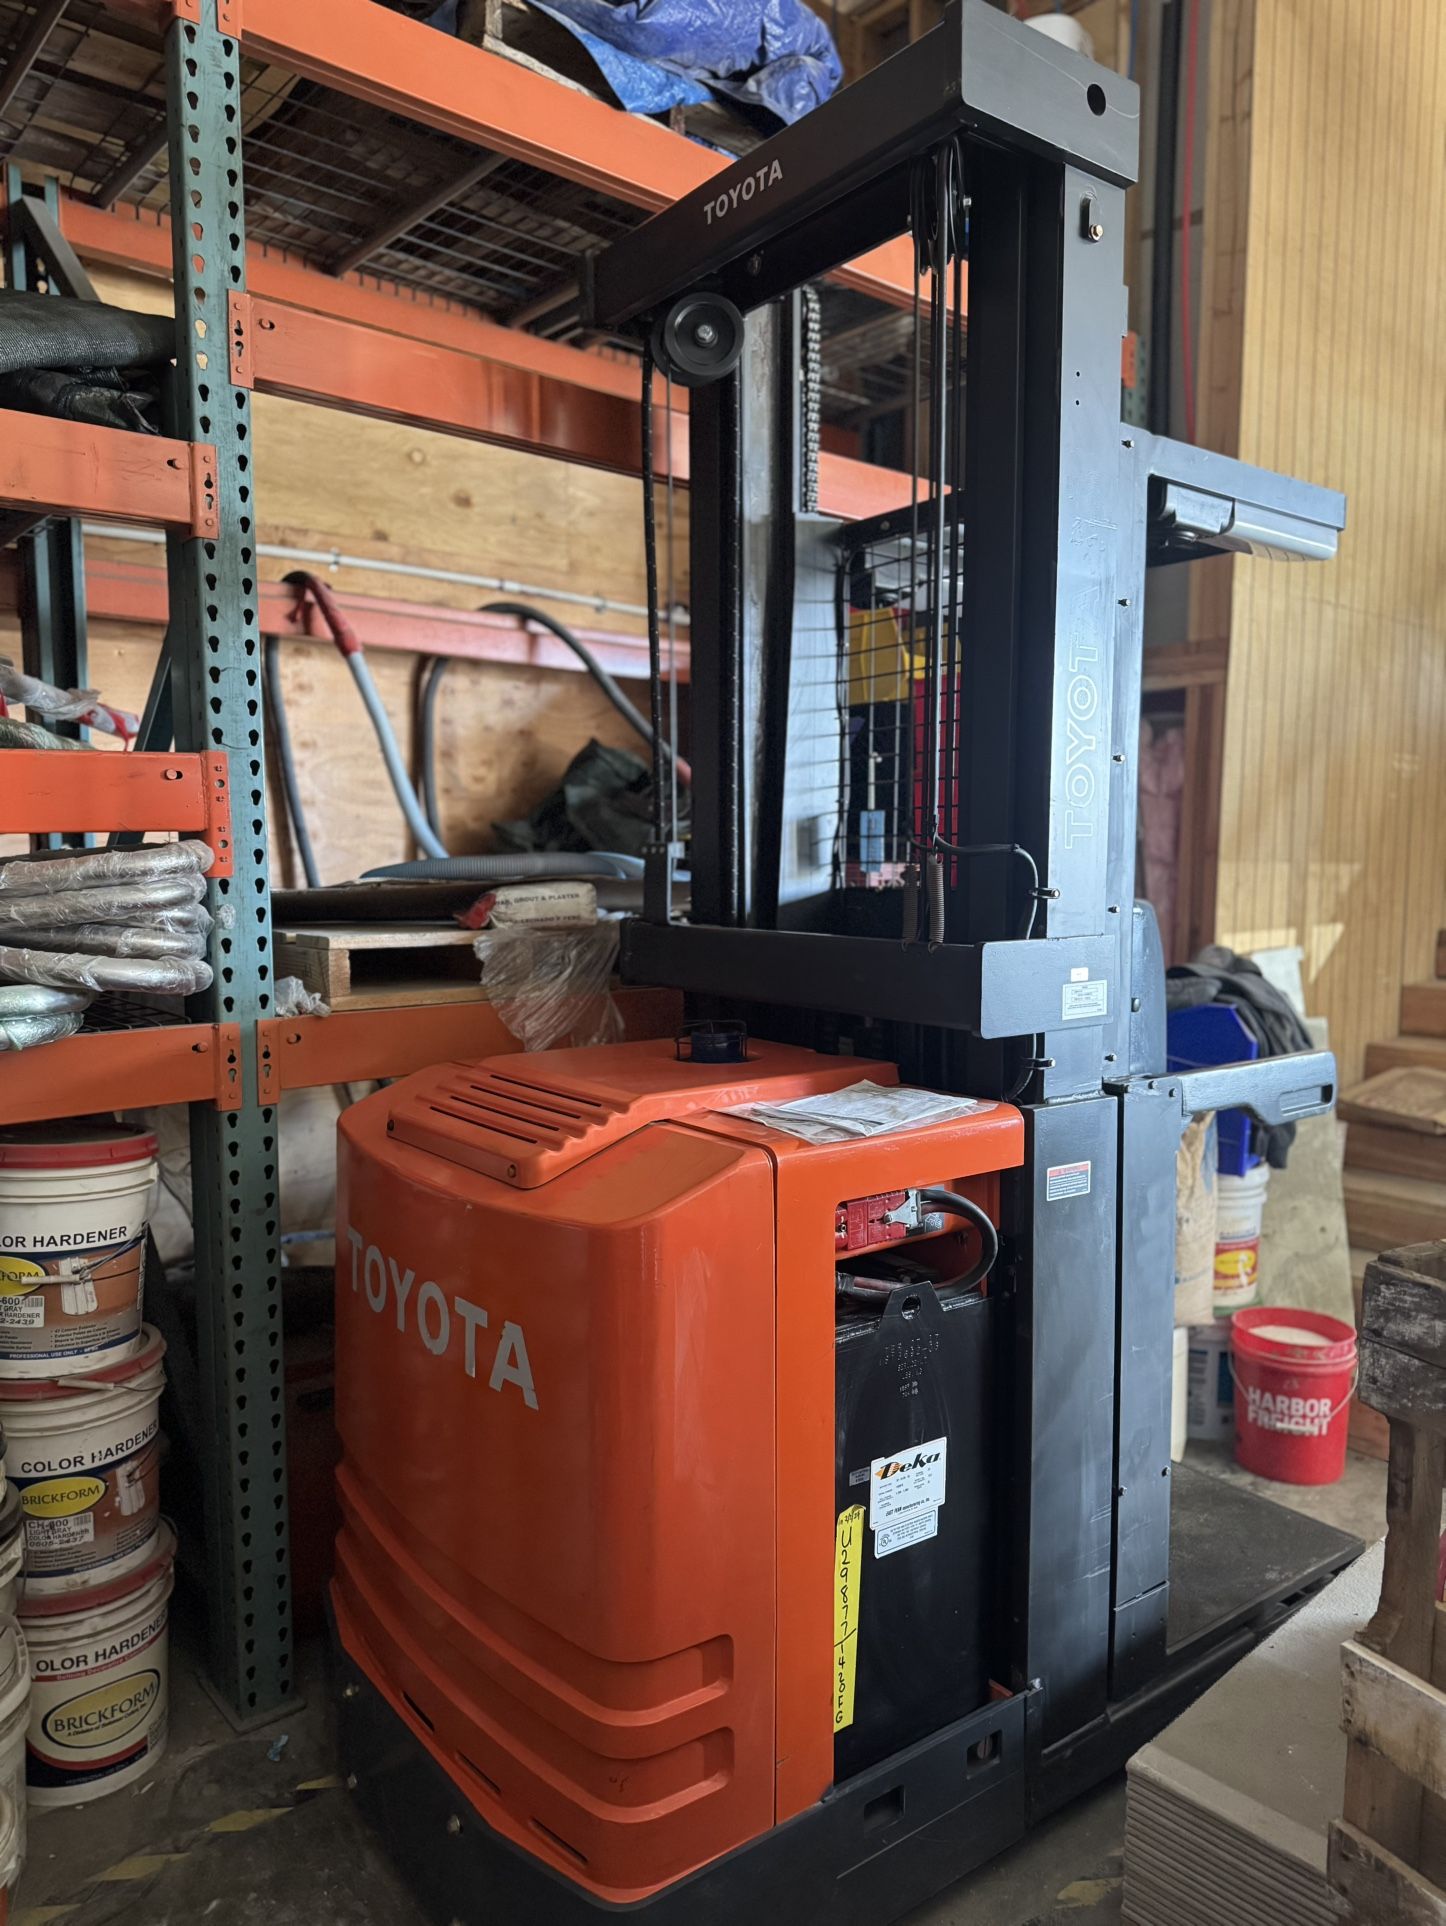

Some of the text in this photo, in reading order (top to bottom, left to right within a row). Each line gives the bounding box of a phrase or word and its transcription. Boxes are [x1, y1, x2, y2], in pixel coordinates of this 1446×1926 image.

[704, 159, 783, 225] TOYOTA
[1064, 584, 1100, 850] TOYOTA
[514, 895, 539, 904] GROUT
[548, 893, 580, 901] PLASTER
[33, 1226, 127, 1248] HARDENER
[4, 1305, 23, 1313] GRAY
[347, 1224, 539, 1411] TOYOTA
[1248, 1385, 1332, 1418] HARBOR
[21, 1418, 158, 1474] COLOR HARDENER
[880, 1452, 941, 1480] Deka
[21, 1484, 100, 1506] BRICKFORM
[54, 1681, 155, 1732] BRICKFORM
